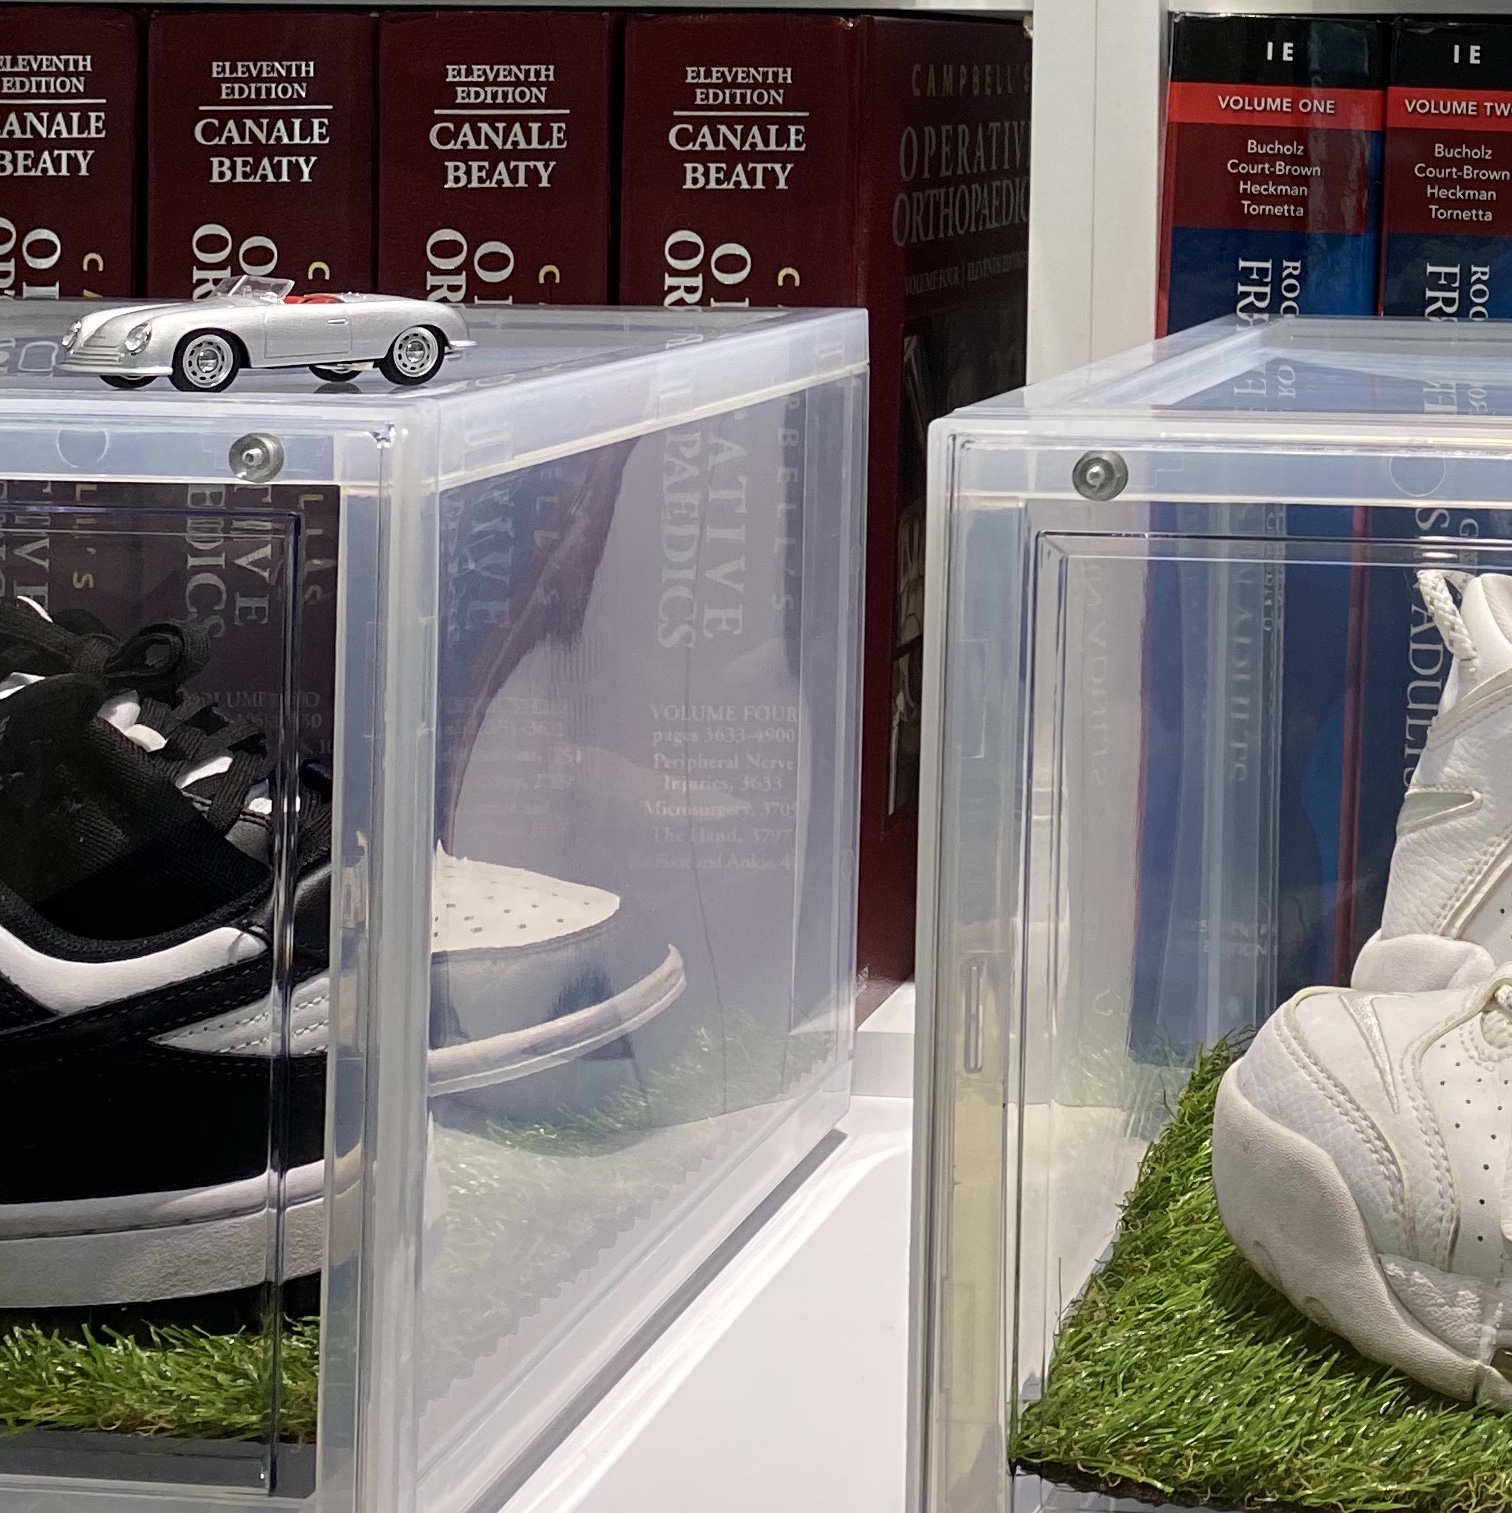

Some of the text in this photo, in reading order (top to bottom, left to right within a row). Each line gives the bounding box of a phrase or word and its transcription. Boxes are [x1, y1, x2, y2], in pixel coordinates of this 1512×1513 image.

[211, 61, 315, 79] ELEVENTH
[446, 64, 555, 83] ELEVENTH
[685, 66, 792, 85] ELEVENTH
[2, 76, 85, 93] EDITION
[220, 83, 307, 100] EDITION
[455, 86, 546, 104] EDITION
[694, 89, 784, 105] EDITION
[1218, 95, 1336, 114] VOLUME ONE
[1404, 98, 1478, 116] VOLUME
[0, 112, 106, 138] ANALE
[194, 119, 330, 146] CANALE
[429, 122, 568, 150] CANALE
[668, 125, 807, 152] CANALE
[899, 120, 1030, 182] OPERATIV
[1247, 139, 1305, 156] Bucholz
[1434, 143, 1493, 161] Bucholz
[0, 150, 94, 176] BEATY
[209, 157, 318, 183] BEATY
[1227, 159, 1321, 177] Court-Brown
[1414, 163, 1511, 181] Court-Brown
[444, 161, 556, 188] BEATY
[683, 163, 794, 190] BEATY
[1239, 180, 1308, 197] Heckman
[1426, 184, 1497, 202] Heckman
[891, 177, 1030, 247] ORTHOPAEDIC
[1241, 200, 1305, 218] Tornetta
[1429, 204, 1493, 222] Tornetta
[650, 704, 798, 723] VOLUME FOUR
[651, 732, 698, 748] pages
[652, 753, 795, 772] Peripheral Nerve
[663, 774, 783, 796] Injuries, 3633
[652, 826, 685, 843] The
